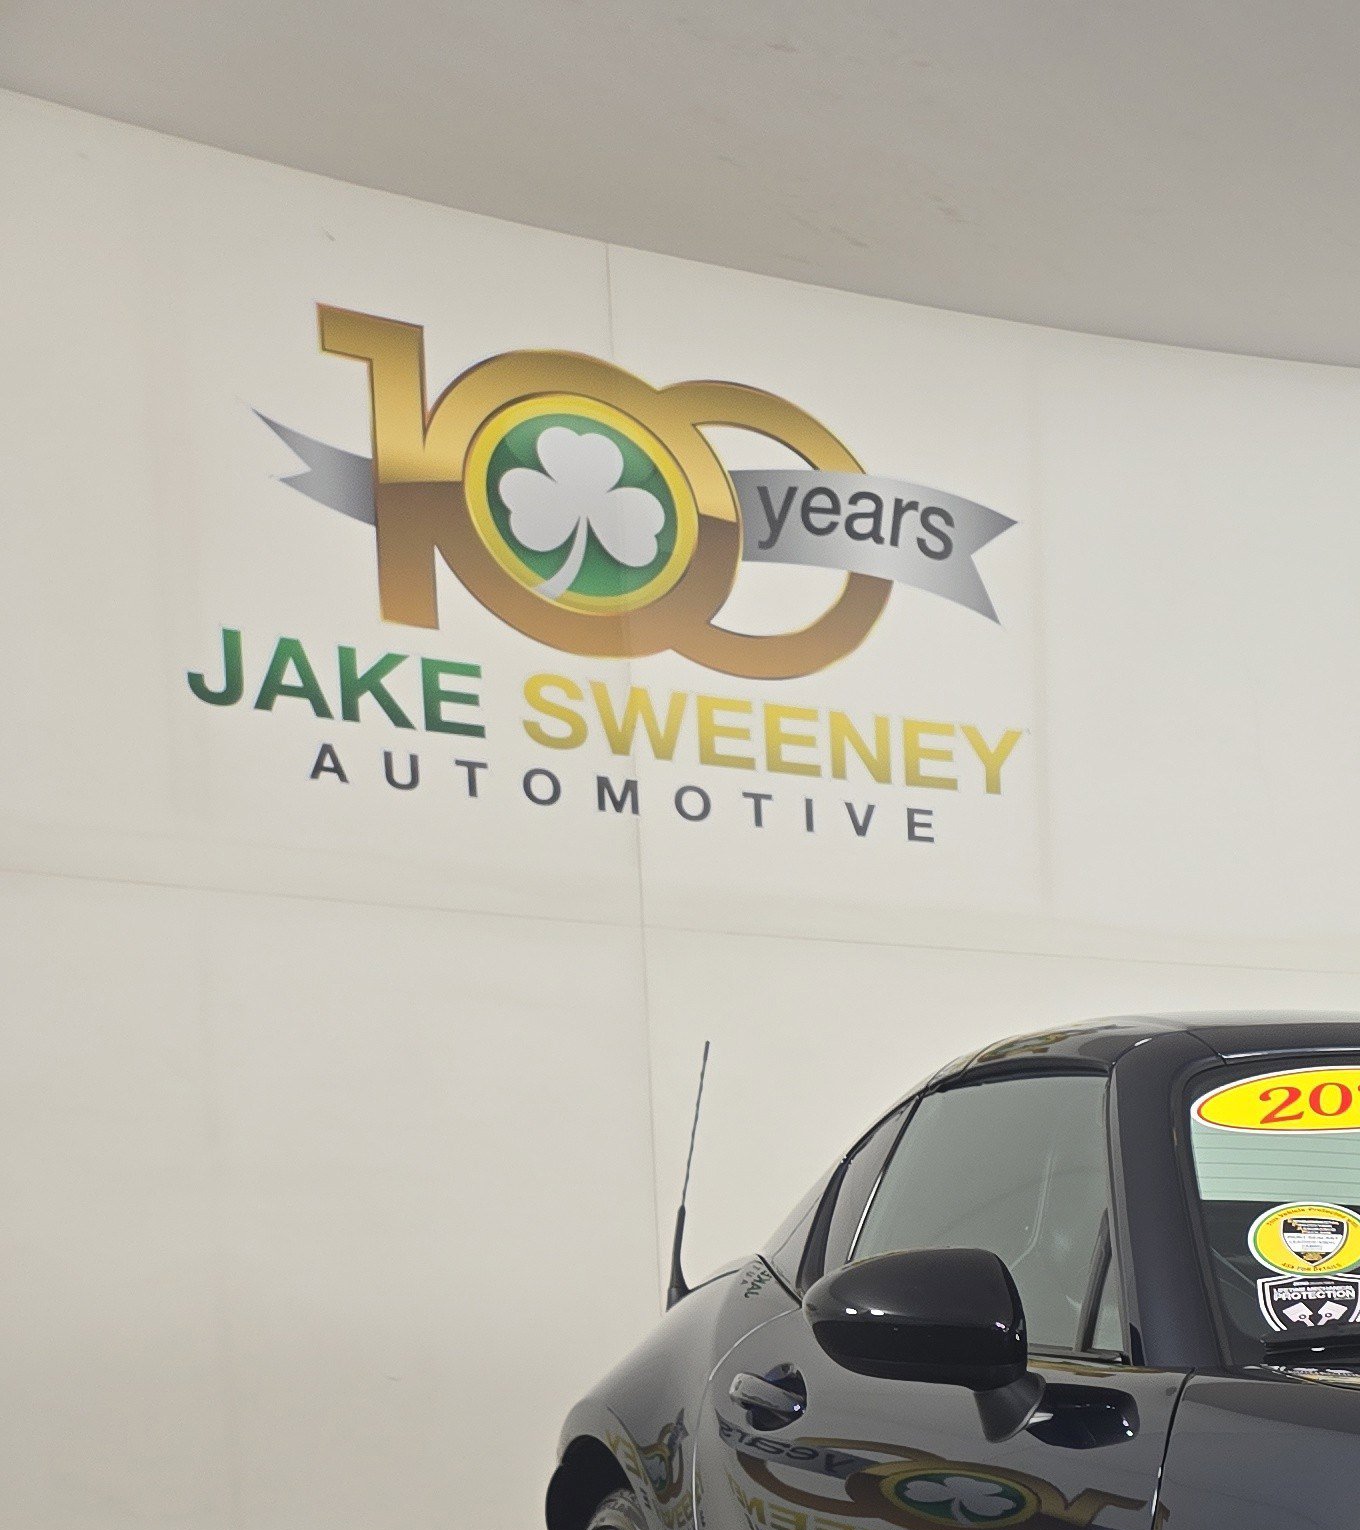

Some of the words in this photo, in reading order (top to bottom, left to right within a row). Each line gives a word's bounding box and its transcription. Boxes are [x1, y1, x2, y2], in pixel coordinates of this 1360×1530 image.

[756, 480, 955, 560] years
[187, 627, 486, 738] JAKE
[521, 672, 1023, 795] SWEENEY
[310, 742, 936, 843] AUTOMOTIVE
[1273, 1288, 1355, 1301] PROTECTION
